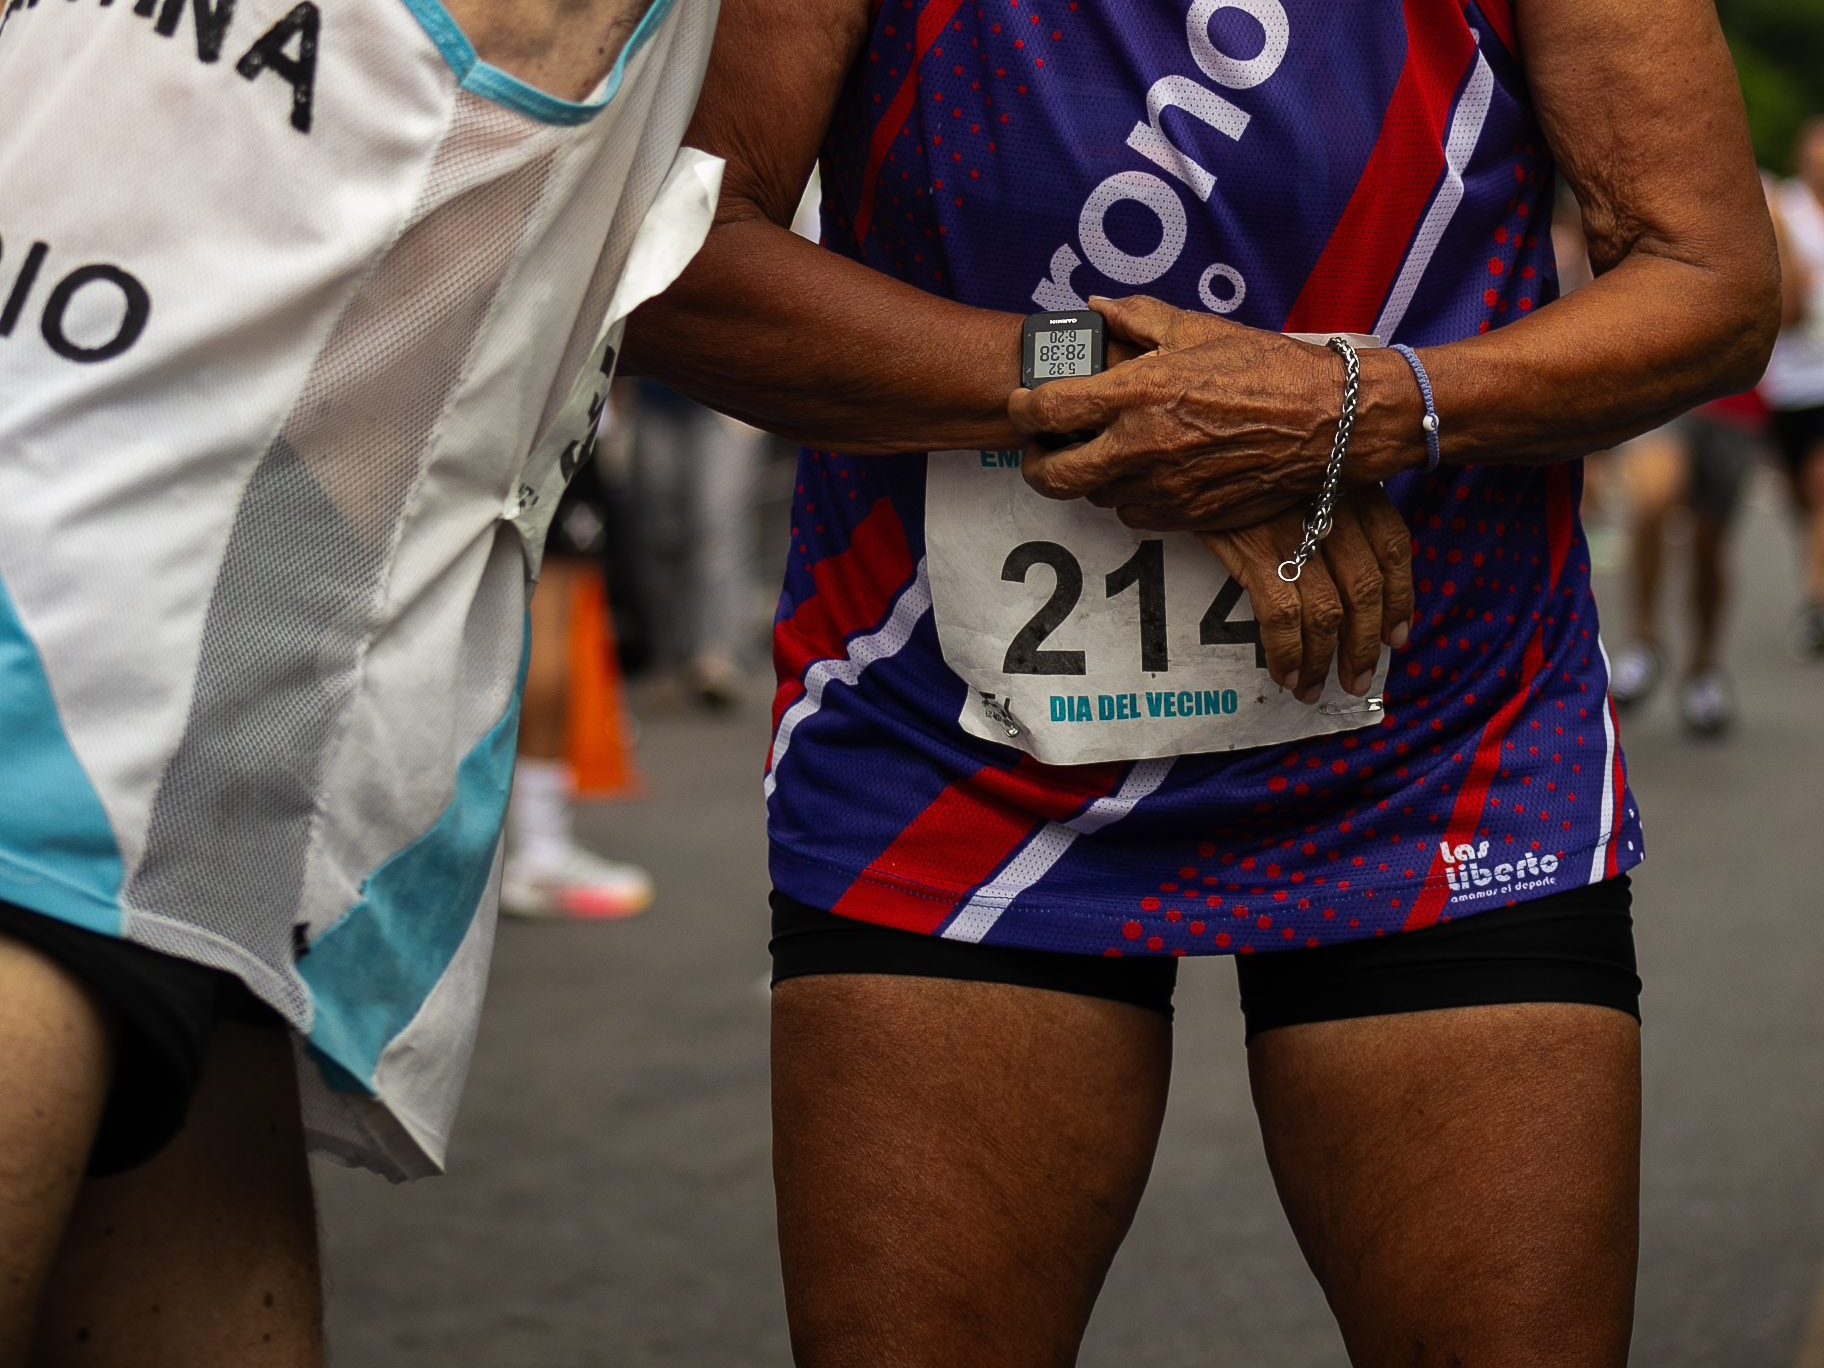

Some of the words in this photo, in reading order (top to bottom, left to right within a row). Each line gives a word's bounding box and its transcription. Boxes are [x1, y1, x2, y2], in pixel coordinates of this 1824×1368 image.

[0, 239, 151, 363] IO
[1049, 317, 1078, 325] GARMIN
[1049, 330, 1077, 344] 6:20
[1039, 343, 1086, 362] 28:38
[1048, 361, 1076, 376] 5.32
[980, 449, 1027, 469] EM
[1049, 695, 1094, 722] DIA
[1097, 692, 1142, 721] DEL
[1145, 688, 1238, 718] VECINO
[1450, 888, 1498, 903] amamos
[1500, 883, 1512, 894] el
[1514, 876, 1557, 891] deporte
